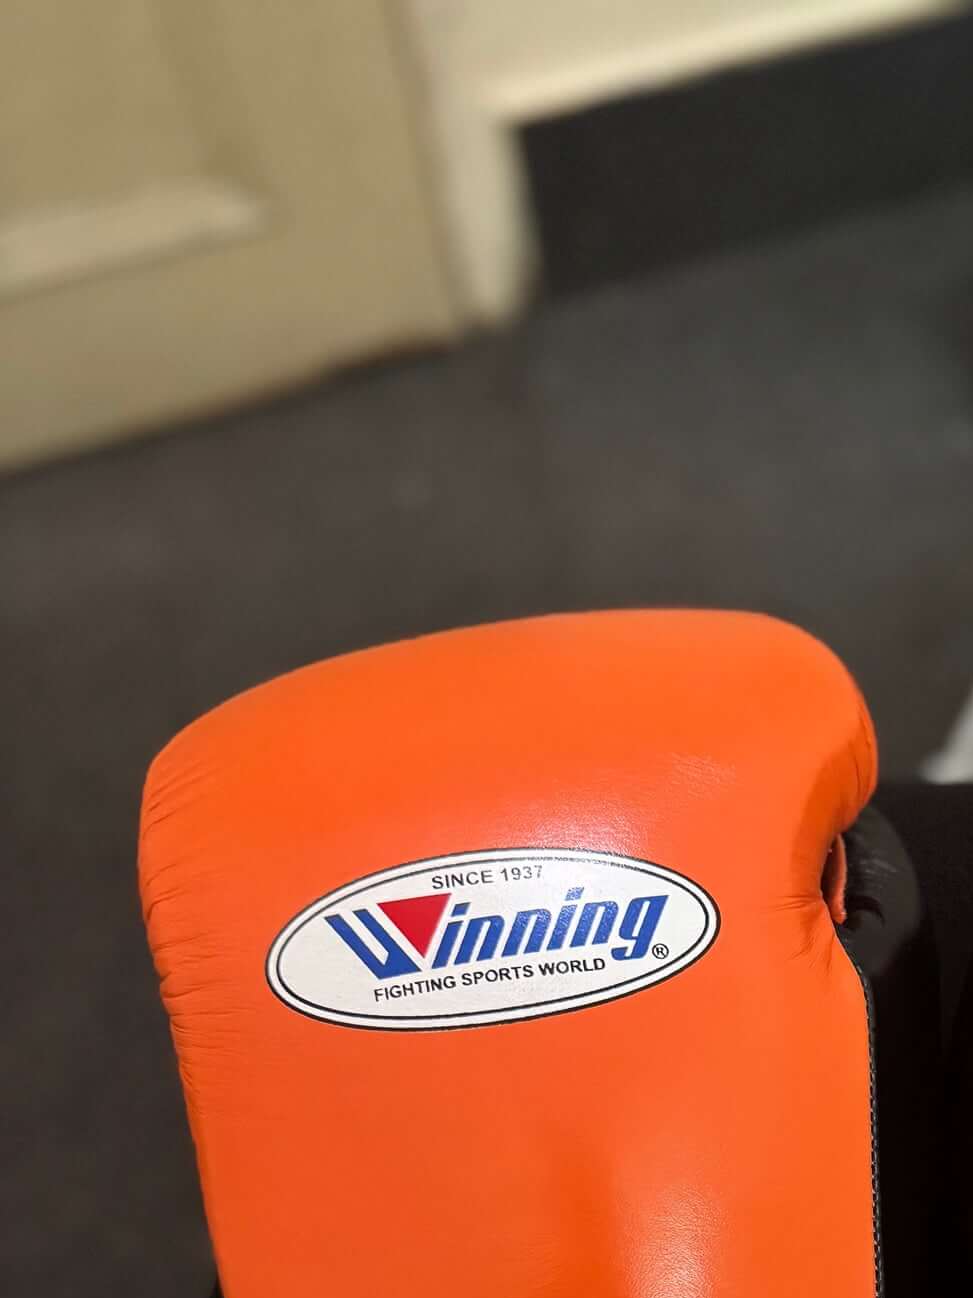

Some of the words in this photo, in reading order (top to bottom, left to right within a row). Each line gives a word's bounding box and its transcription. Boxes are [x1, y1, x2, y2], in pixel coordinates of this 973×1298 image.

[431, 869, 494, 890] SINCE
[500, 865, 544, 882] 1937
[324, 886, 670, 980] Winning
[374, 975, 456, 1003] FIGHTING
[461, 964, 534, 987] SPORTS
[538, 957, 606, 976] WORLD
